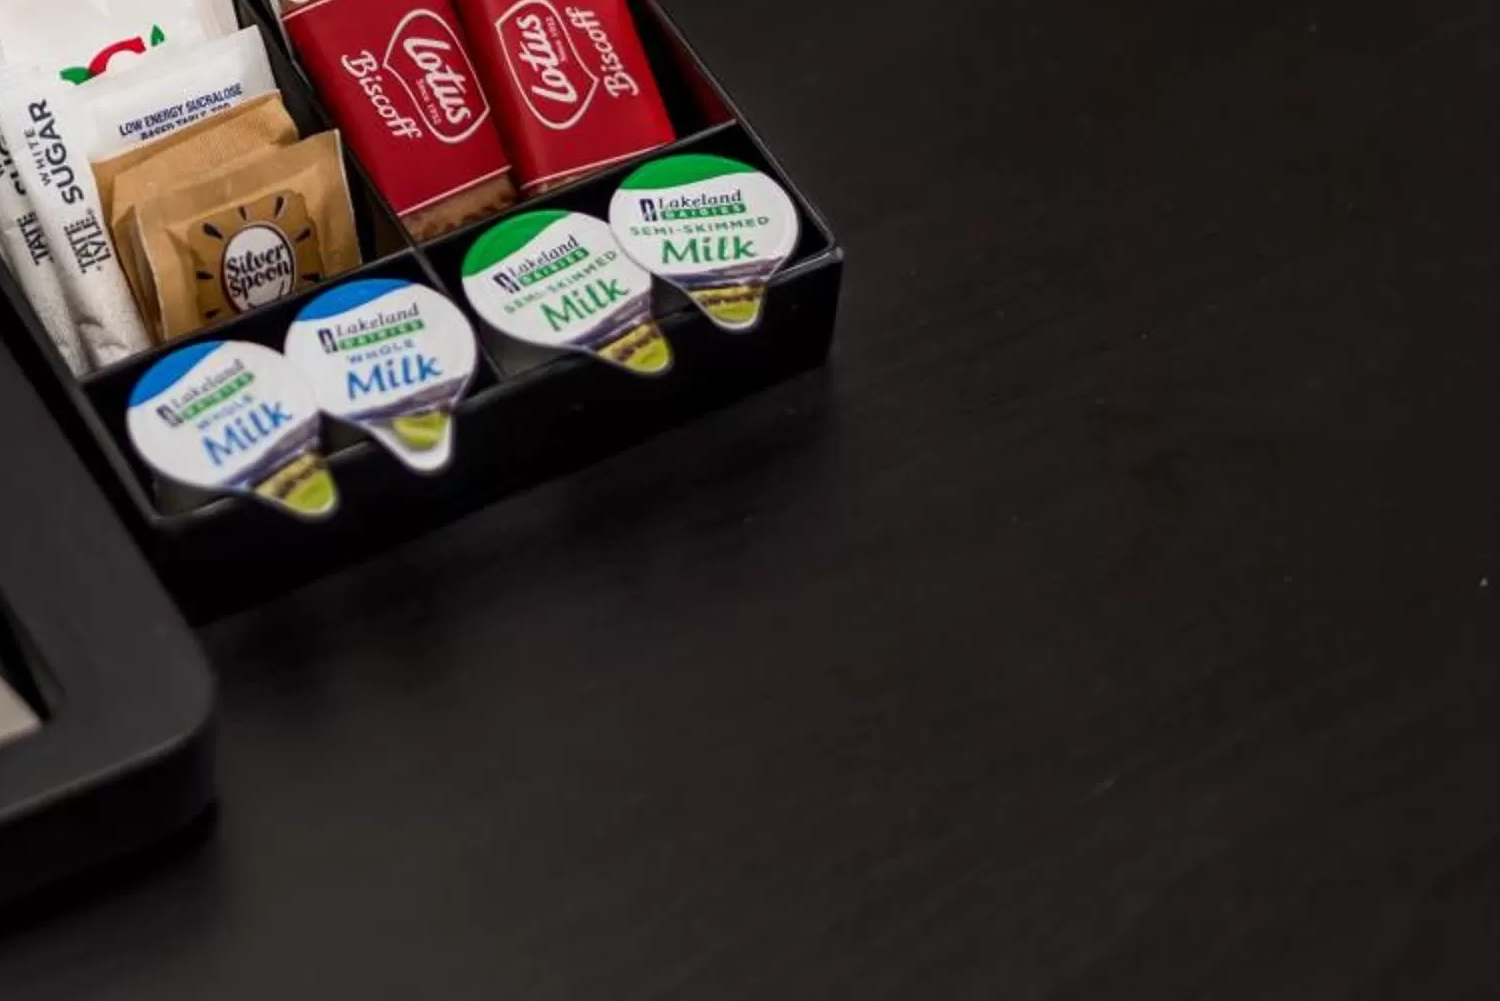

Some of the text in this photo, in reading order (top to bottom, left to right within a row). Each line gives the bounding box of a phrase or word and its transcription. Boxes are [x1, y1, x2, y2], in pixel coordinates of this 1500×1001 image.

[516, 13, 579, 104] Lotus
[565, 6, 639, 99] Biscoff
[341, 50, 423, 140] Biscoff
[403, 37, 472, 125] Lotus
[118, 83, 243, 137] LOW ENERGY SUCRALOSE
[24, 128, 52, 186] WHITE
[28, 99, 85, 205] SUGAR
[629, 215, 770, 237] SEMI-SKIMMED
[658, 189, 742, 210] Lakeland
[16, 211, 50, 266] TATE
[63, 220, 98, 275] TATE
[226, 244, 284, 280] Silver
[508, 235, 580, 278] Lakeland
[662, 236, 757, 265] Milk
[503, 249, 619, 316] SEMI-SKIMMED
[539, 275, 630, 332] Milk
[336, 303, 421, 337] Lakeland
[346, 353, 442, 401] Milk
[201, 399, 293, 467] Milk
